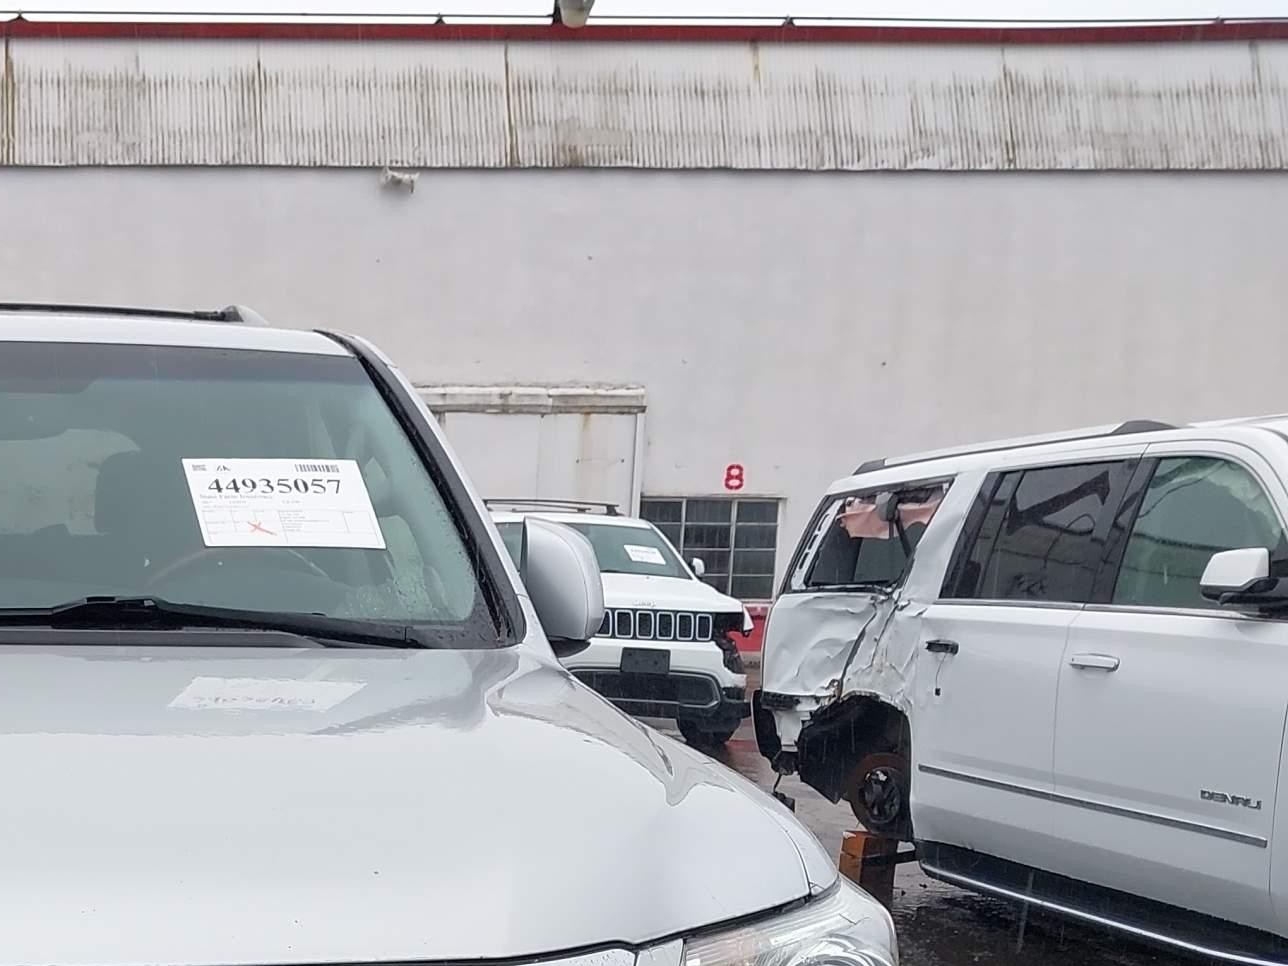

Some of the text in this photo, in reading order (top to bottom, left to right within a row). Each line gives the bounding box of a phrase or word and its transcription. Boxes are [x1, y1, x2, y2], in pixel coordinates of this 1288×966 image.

[207, 478, 341, 494] 44935057
[724, 463, 744, 491] 8
[1200, 789, 1262, 810] DENALI
